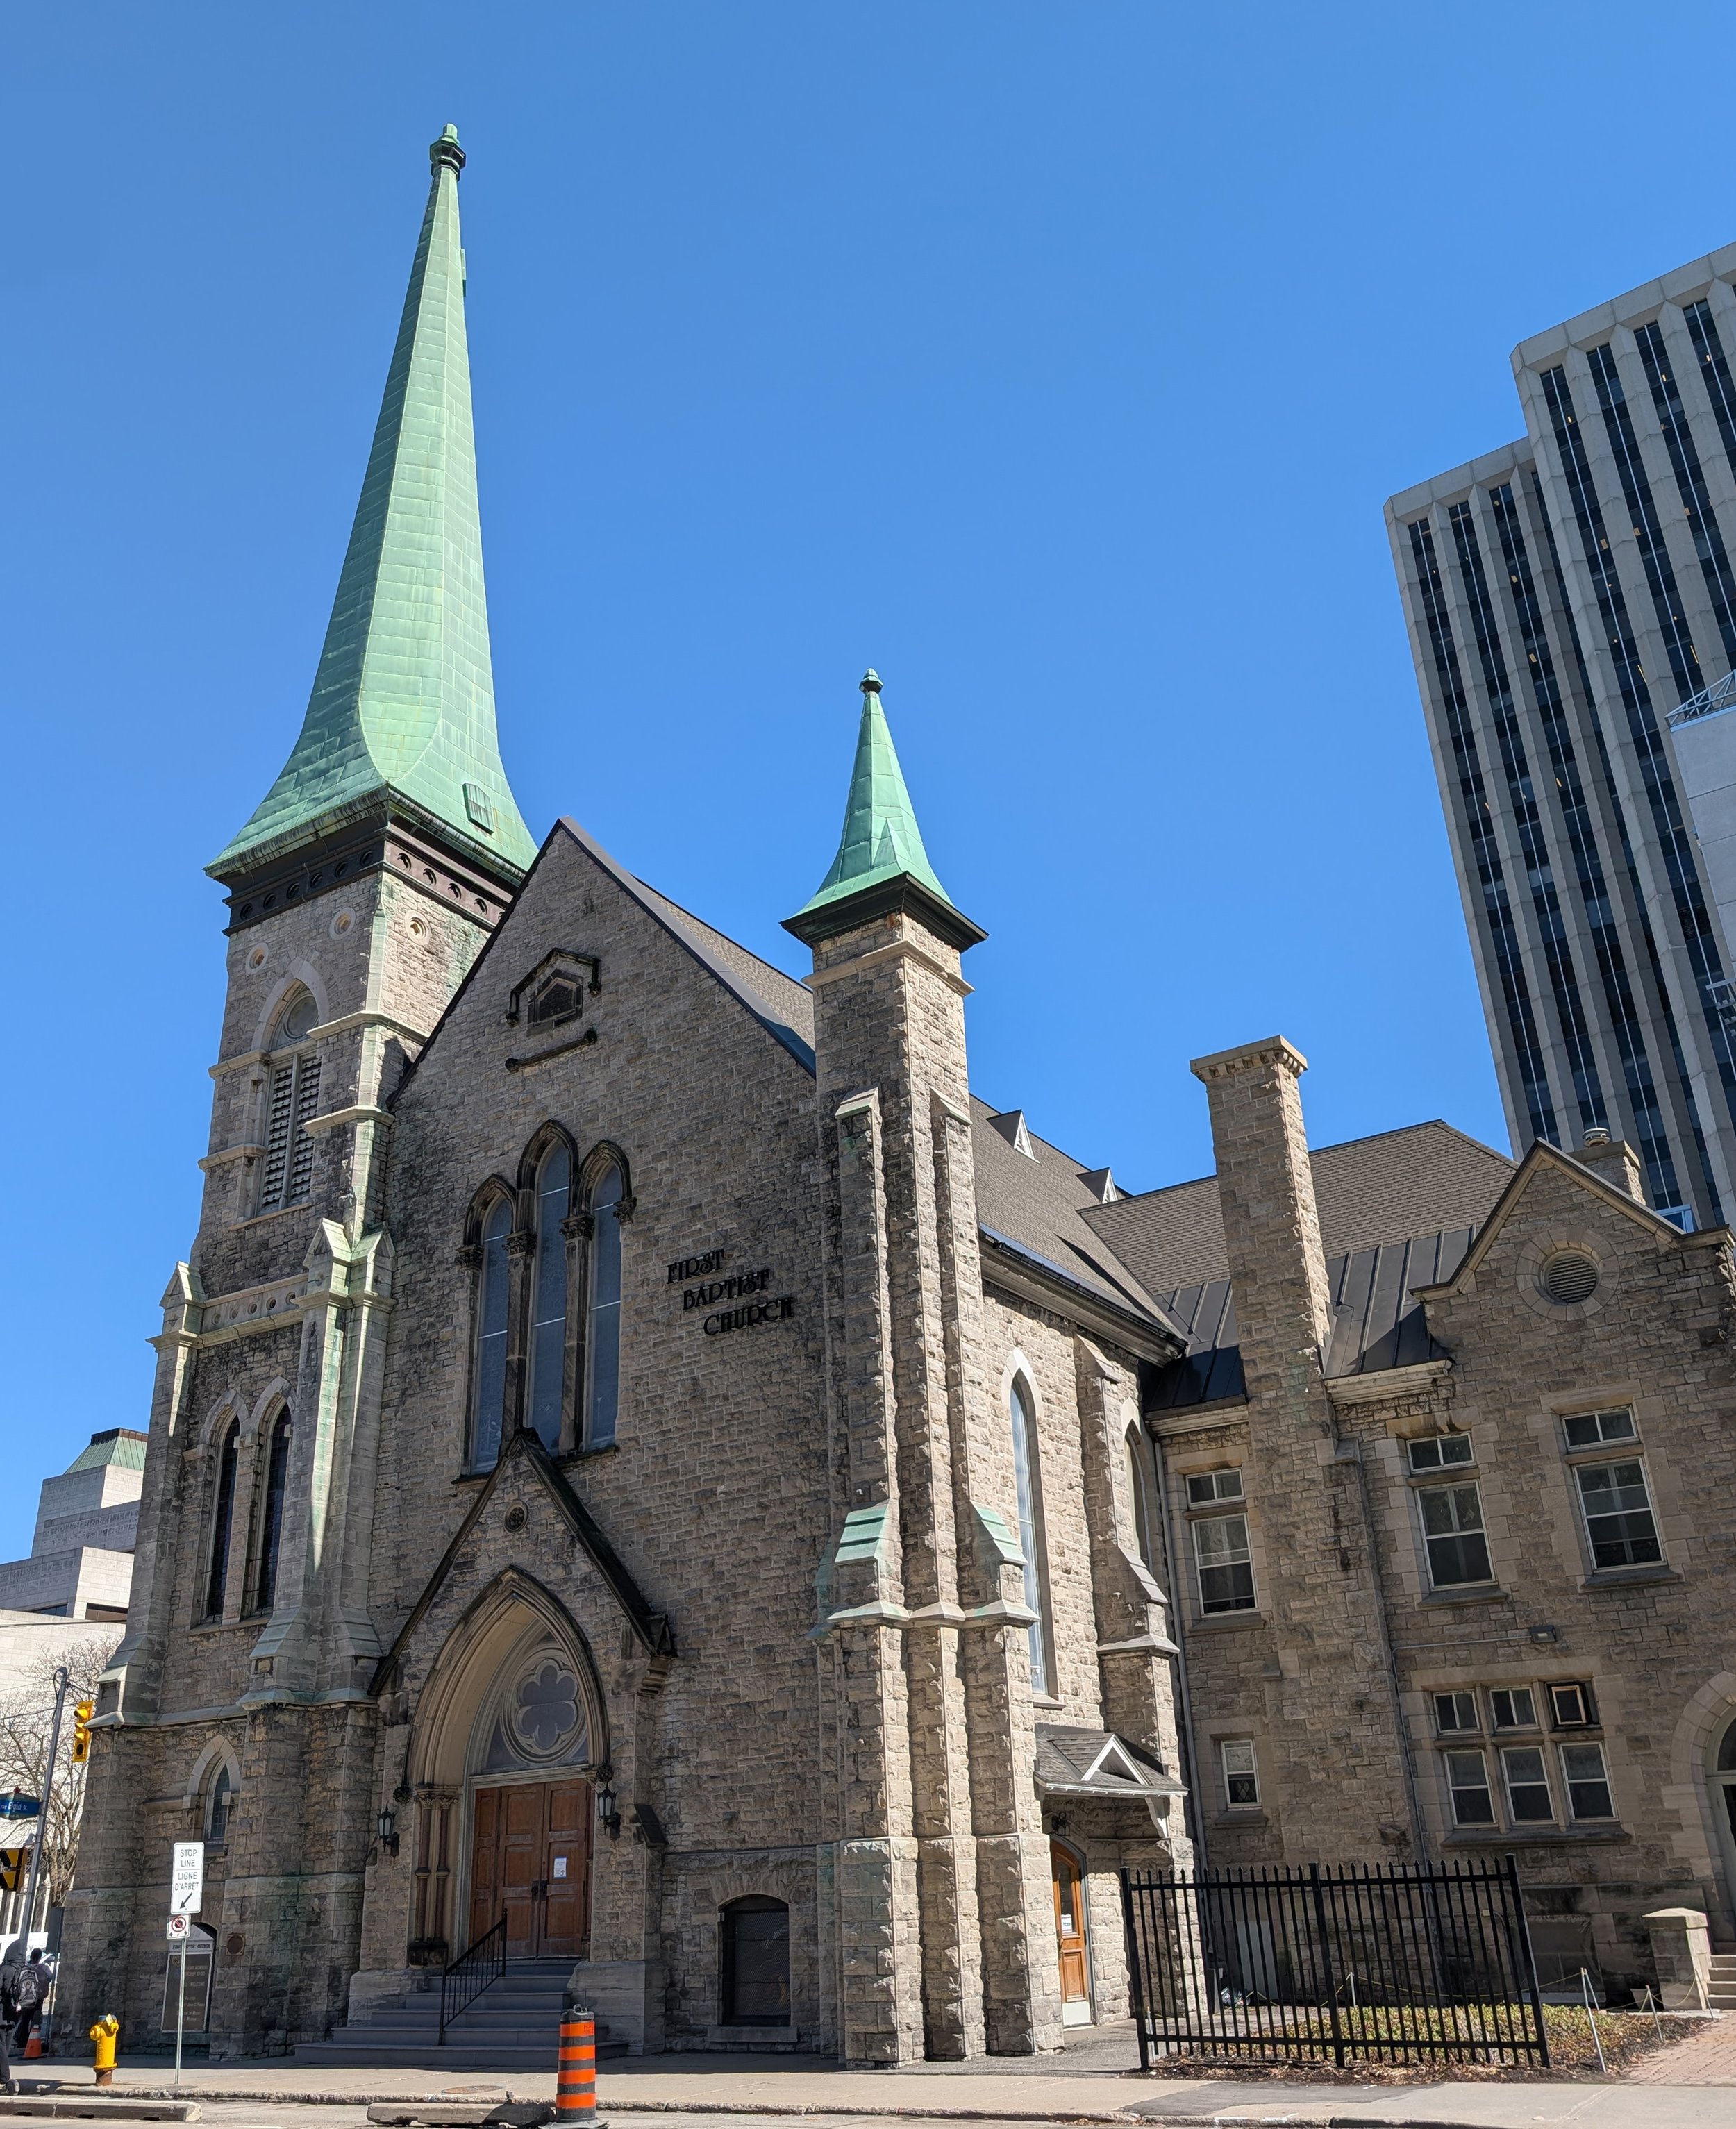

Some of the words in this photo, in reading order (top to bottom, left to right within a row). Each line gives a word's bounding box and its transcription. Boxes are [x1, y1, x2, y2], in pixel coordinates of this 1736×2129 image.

[667, 1249, 724, 1284] FIRST
[683, 1269, 769, 1310] BAPTIST
[703, 1297, 794, 1335] CHURCH
[8, 1801, 22, 1812] Elgin
[181, 1859, 195, 1867] LINE
[178, 1872, 197, 1880] LIGNE
